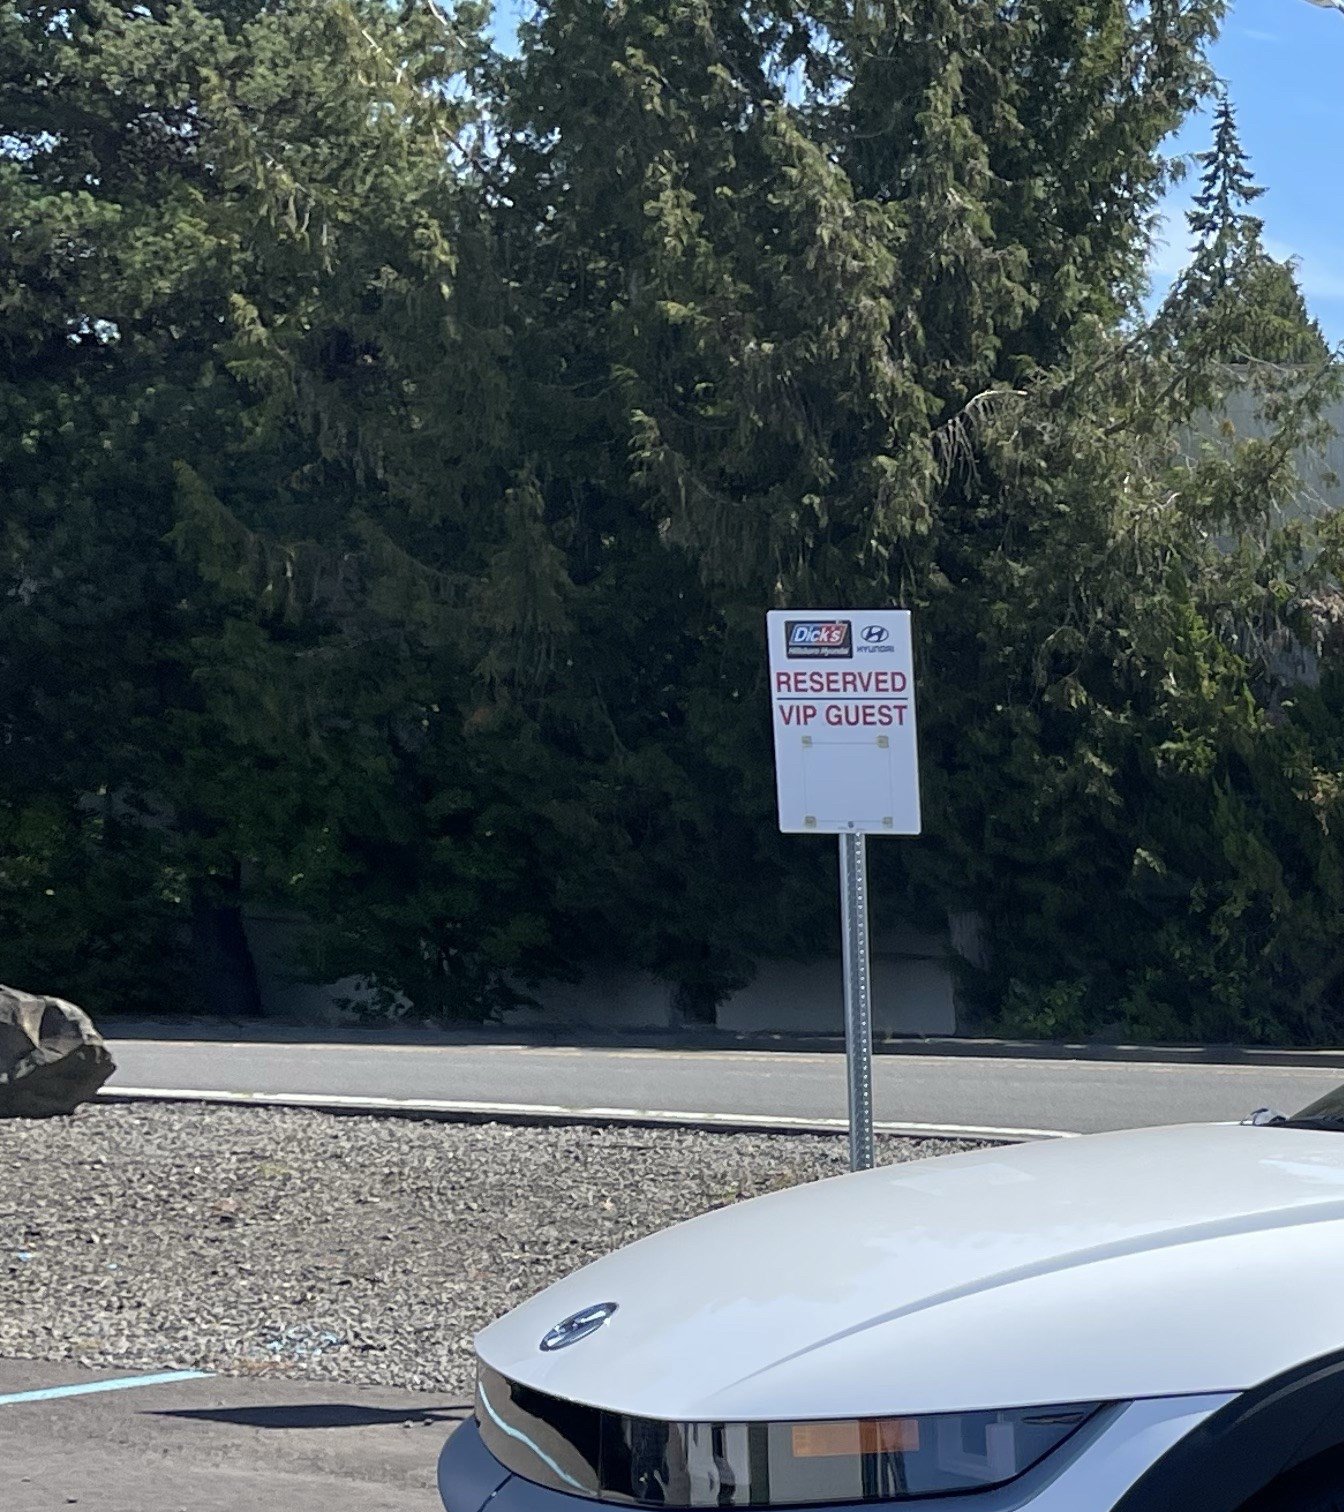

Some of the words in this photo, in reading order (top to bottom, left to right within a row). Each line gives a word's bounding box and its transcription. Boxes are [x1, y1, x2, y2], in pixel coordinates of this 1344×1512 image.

[776, 671, 907, 692] RESERVED
[779, 705, 817, 725] VIP
[825, 705, 908, 726] GUEST
